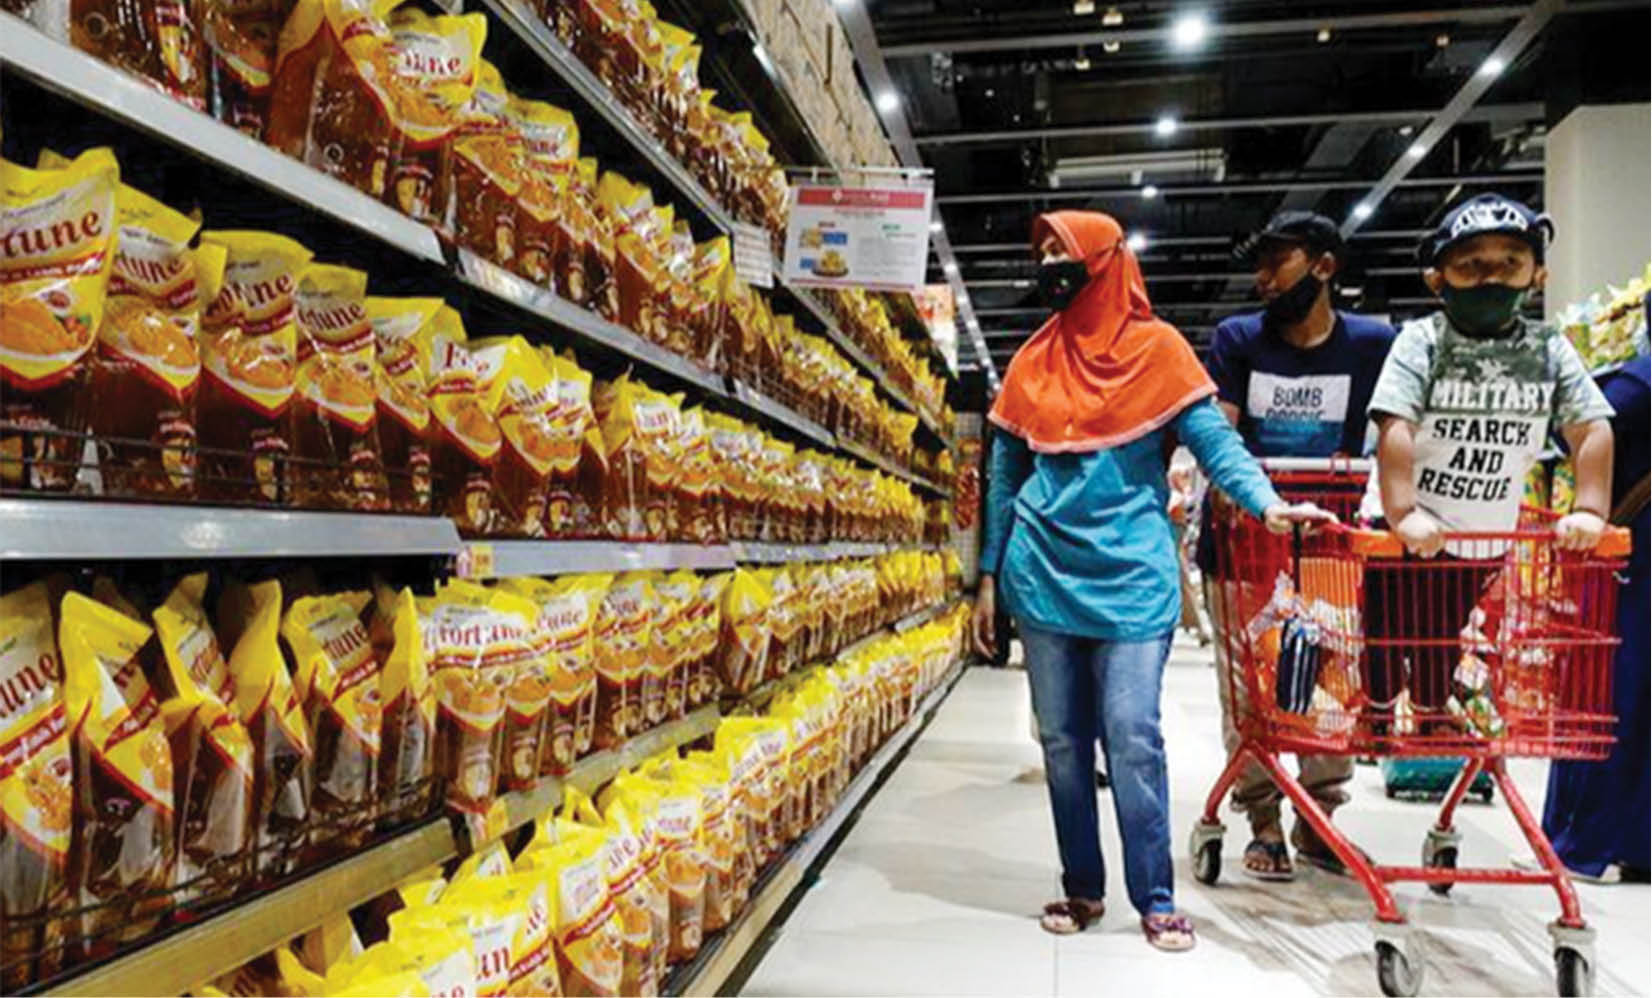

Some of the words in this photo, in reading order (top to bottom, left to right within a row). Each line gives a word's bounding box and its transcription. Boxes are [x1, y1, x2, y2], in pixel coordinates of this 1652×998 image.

[1273, 386, 1323, 407] BOMB
[1430, 379, 1556, 416] MILITARY
[1432, 418, 1531, 446] SEARCH
[1448, 447, 1504, 474] AND
[1417, 467, 1511, 501] RESCUE
